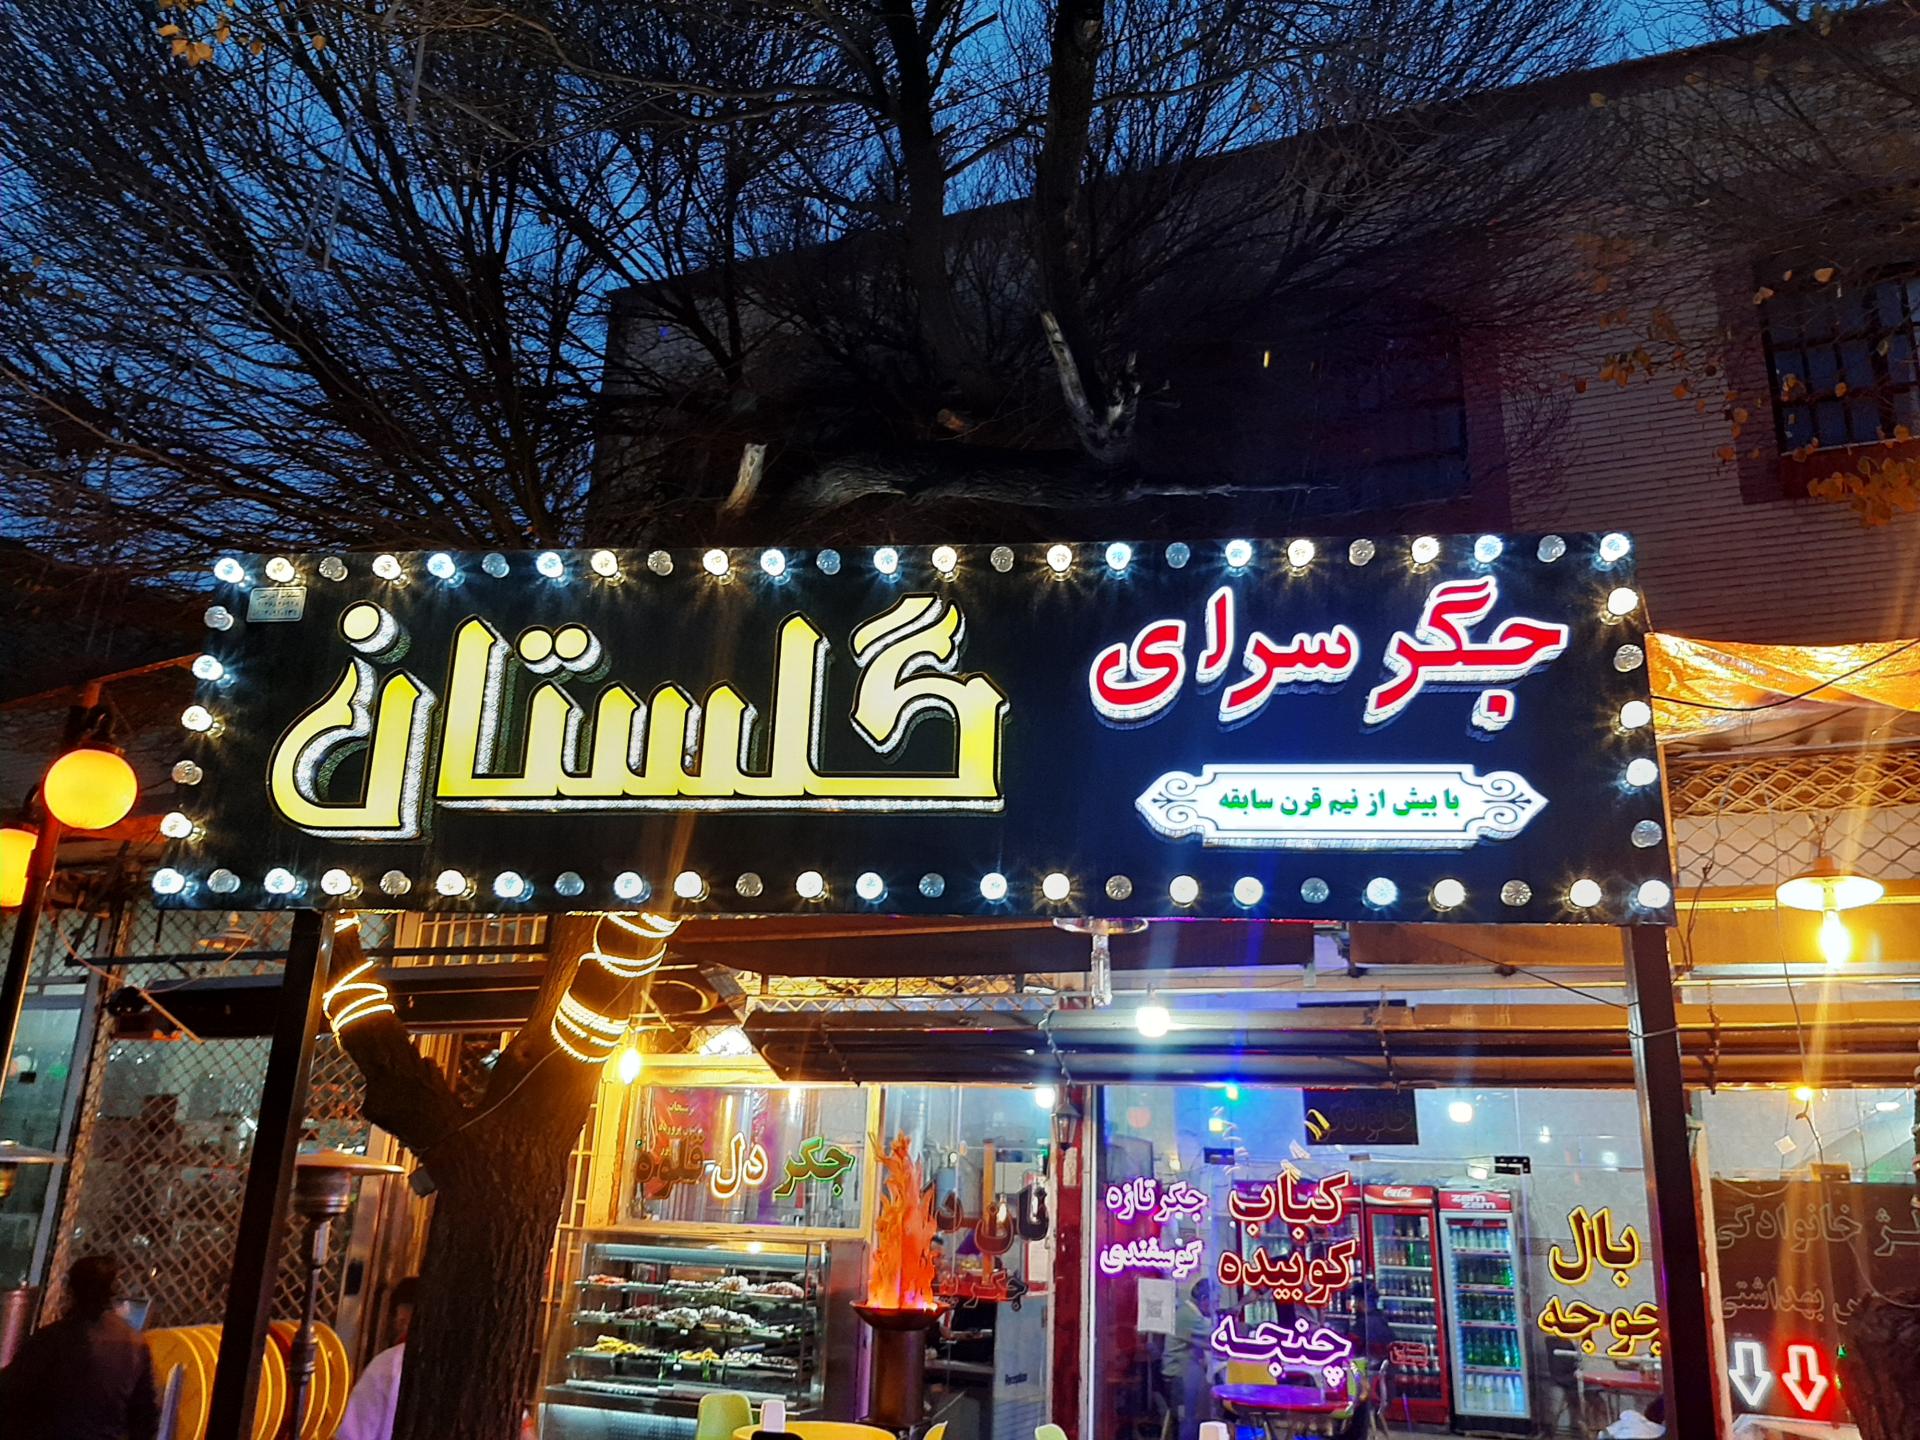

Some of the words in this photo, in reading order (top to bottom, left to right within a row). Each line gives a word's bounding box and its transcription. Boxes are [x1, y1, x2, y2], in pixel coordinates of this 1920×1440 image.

[1362, 576, 1569, 732] جگر
[268, 593, 1008, 834] گلستان
[1218, 788, 1273, 815] سابقه
[1280, 786, 1322, 817] قرن
[1328, 788, 1359, 815] نیم
[1366, 788, 1386, 817] از
[1393, 786, 1438, 817] بیش
[1443, 787, 1460, 817] با
[711, 1131, 769, 1199] دل
[1106, 1176, 1157, 1220] تازه
[1229, 1170, 1350, 1239] کباب
[1218, 1239, 1357, 1304] کوبیده
[1548, 1205, 1642, 1289] بال
[1537, 1294, 1664, 1358] جوجه
[1721, 1275, 1825, 1322] بهداشتی
[1210, 1314, 1354, 1388] چنجه
